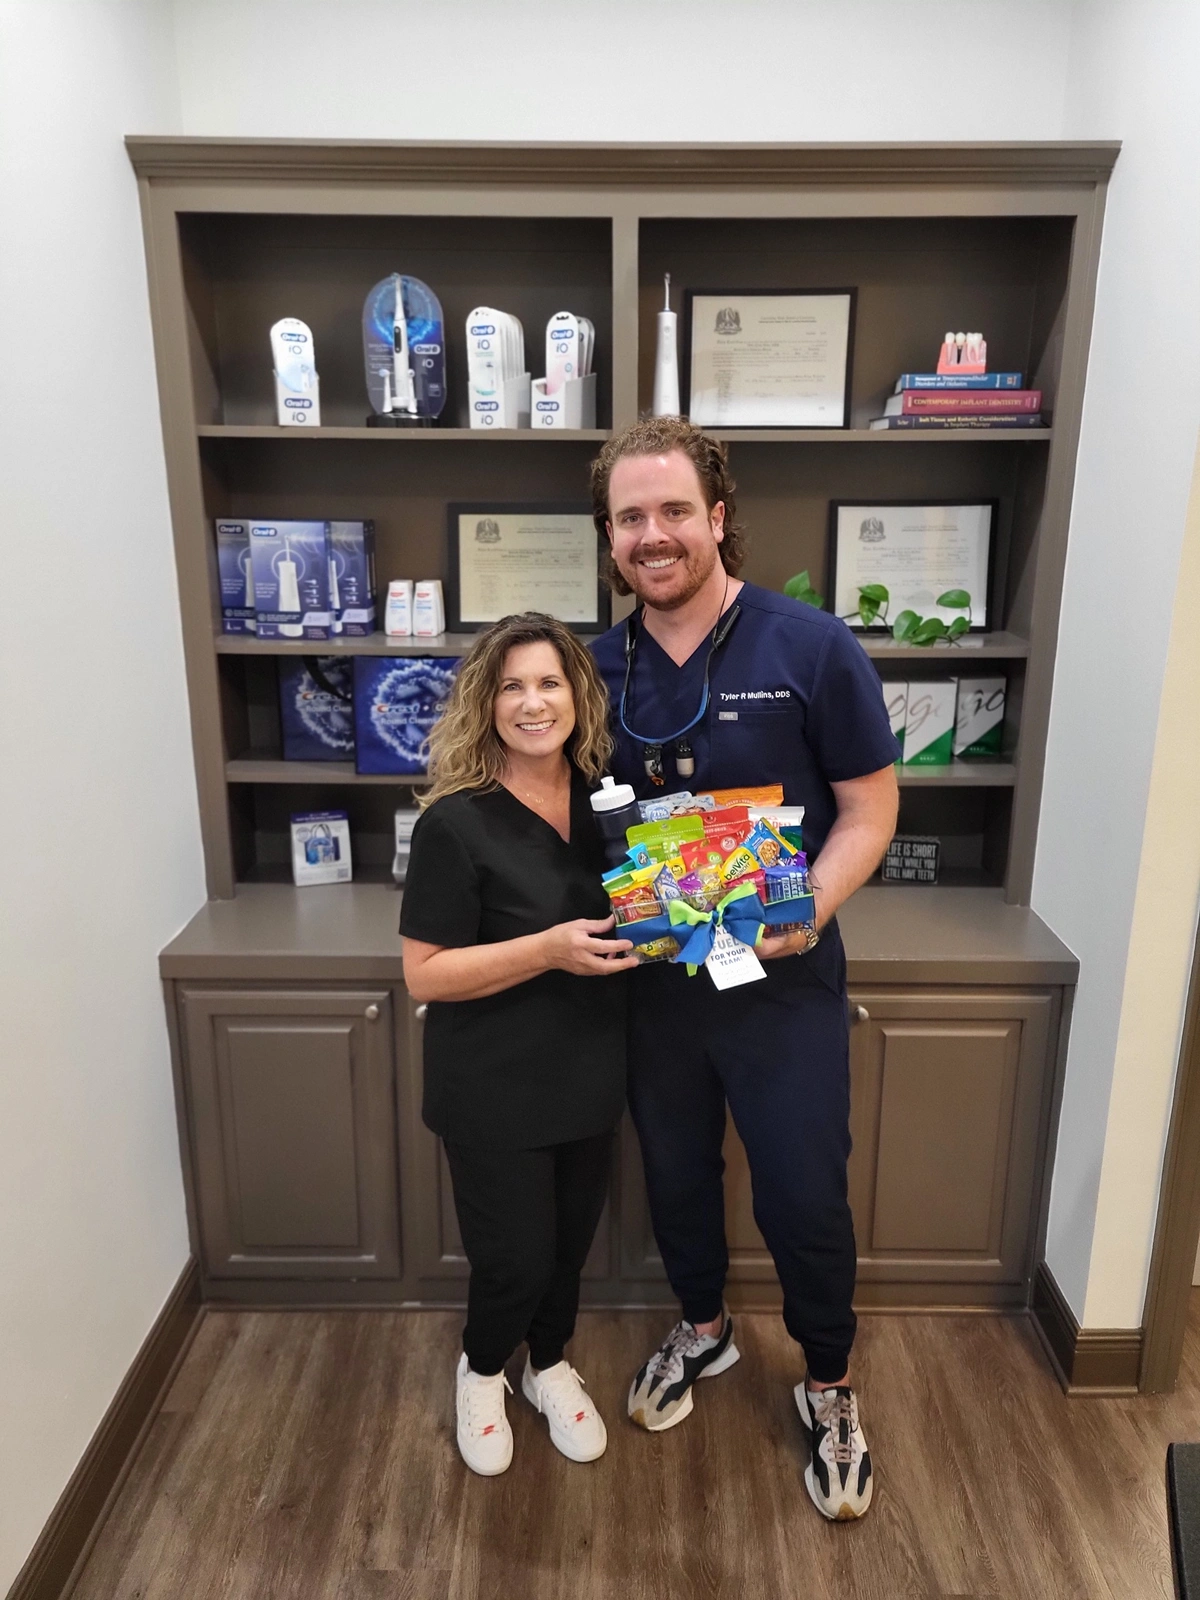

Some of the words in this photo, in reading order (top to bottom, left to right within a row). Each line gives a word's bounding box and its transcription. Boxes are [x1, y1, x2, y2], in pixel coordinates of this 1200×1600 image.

[285, 399, 312, 408] Oral-B
[475, 402, 498, 411] Oral-B
[537, 402, 559, 411] Oral-B
[913, 398, 960, 406] CONTEMPORARY
[960, 398, 988, 406] IMPLANT
[253, 528, 277, 537] Oral-B
[720, 692, 739, 701] Tyler
[747, 690, 774, 699] Mullins,
[775, 690, 791, 698] DDS
[377, 702, 419, 713] Crest
[887, 842, 902, 856] LIFE
[903, 843, 911, 856] IS
[912, 843, 937, 858] SHORT
[724, 853, 751, 880] belVita
[886, 856, 903, 867] SMILE
[904, 857, 922, 869] WHILE
[923, 859, 936, 870] YOU
[886, 867, 901, 879] STILL
[901, 868, 916, 880] HAVE
[917, 869, 936, 881] TEETH
[713, 937, 739, 951] FUEL
[711, 953, 726, 962] FOR
[726, 947, 747, 957] YOUR
[720, 955, 743, 966] TEAM!
